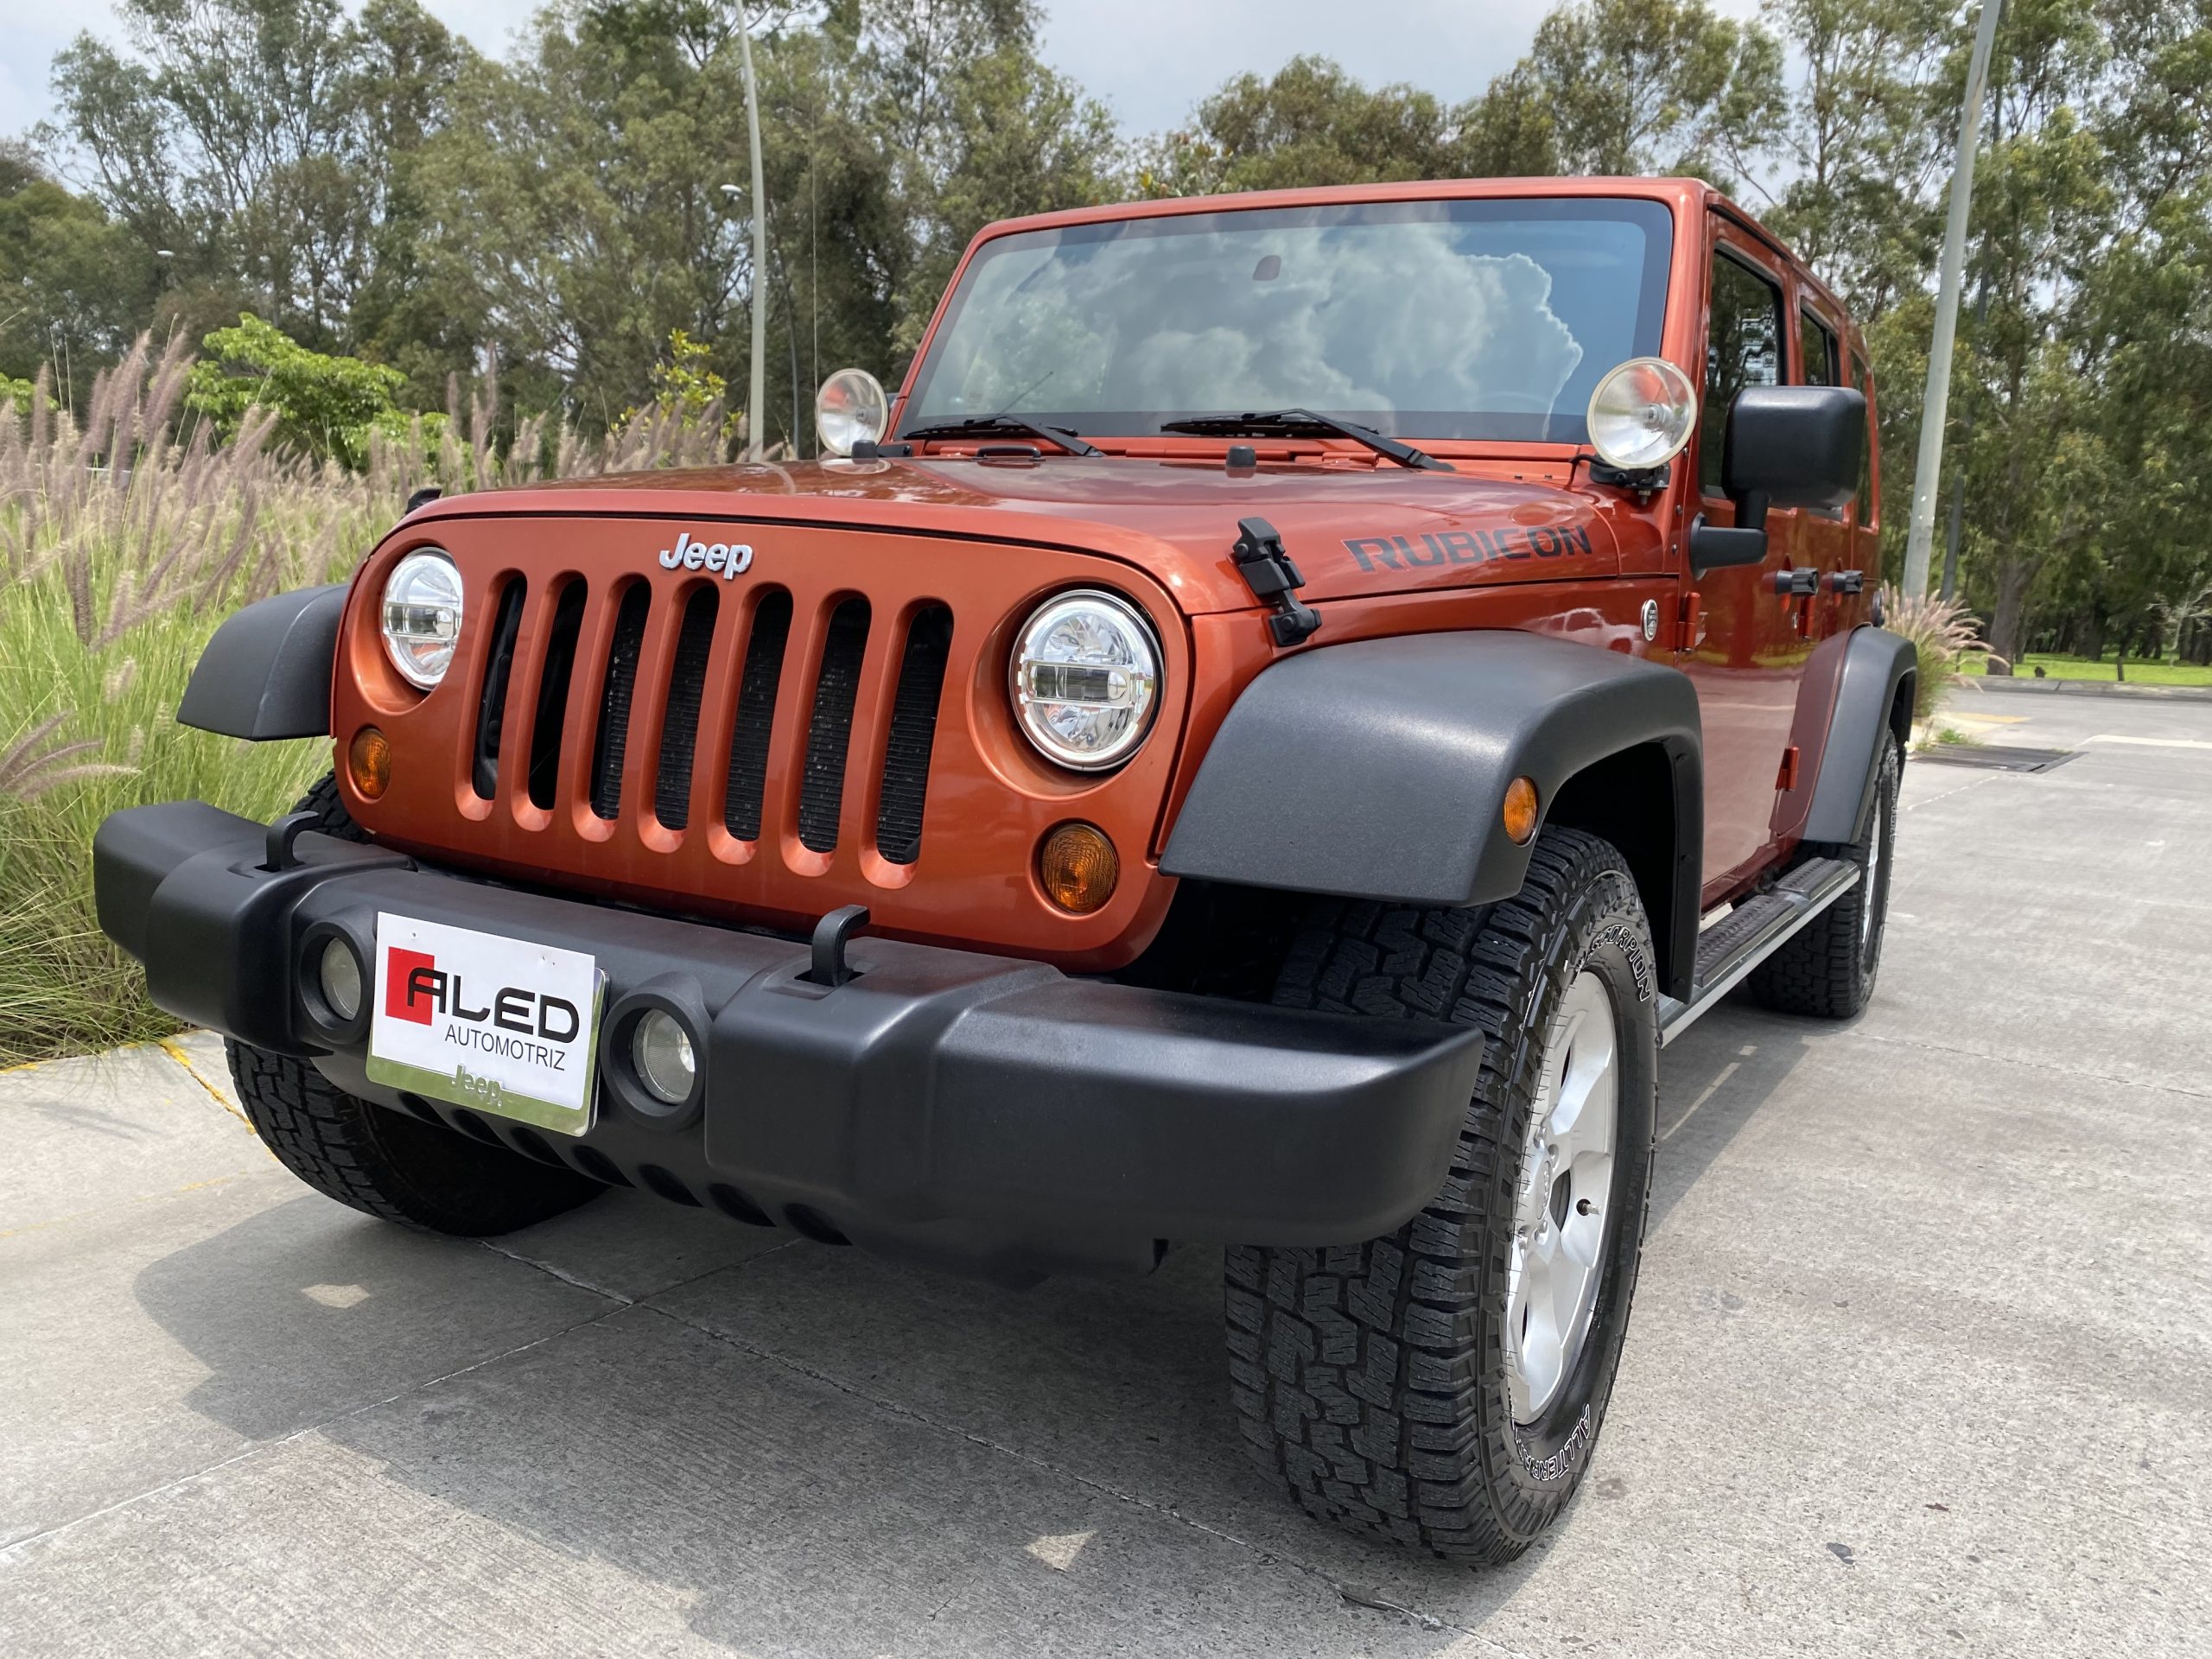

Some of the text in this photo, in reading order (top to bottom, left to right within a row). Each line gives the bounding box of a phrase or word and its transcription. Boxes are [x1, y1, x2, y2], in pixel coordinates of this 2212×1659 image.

[658, 532, 753, 581] Jeep
[1341, 524, 1592, 573] RUBICON
[406, 967, 580, 1044] ALED
[444, 1024, 566, 1071] AUTOMOTRIZ
